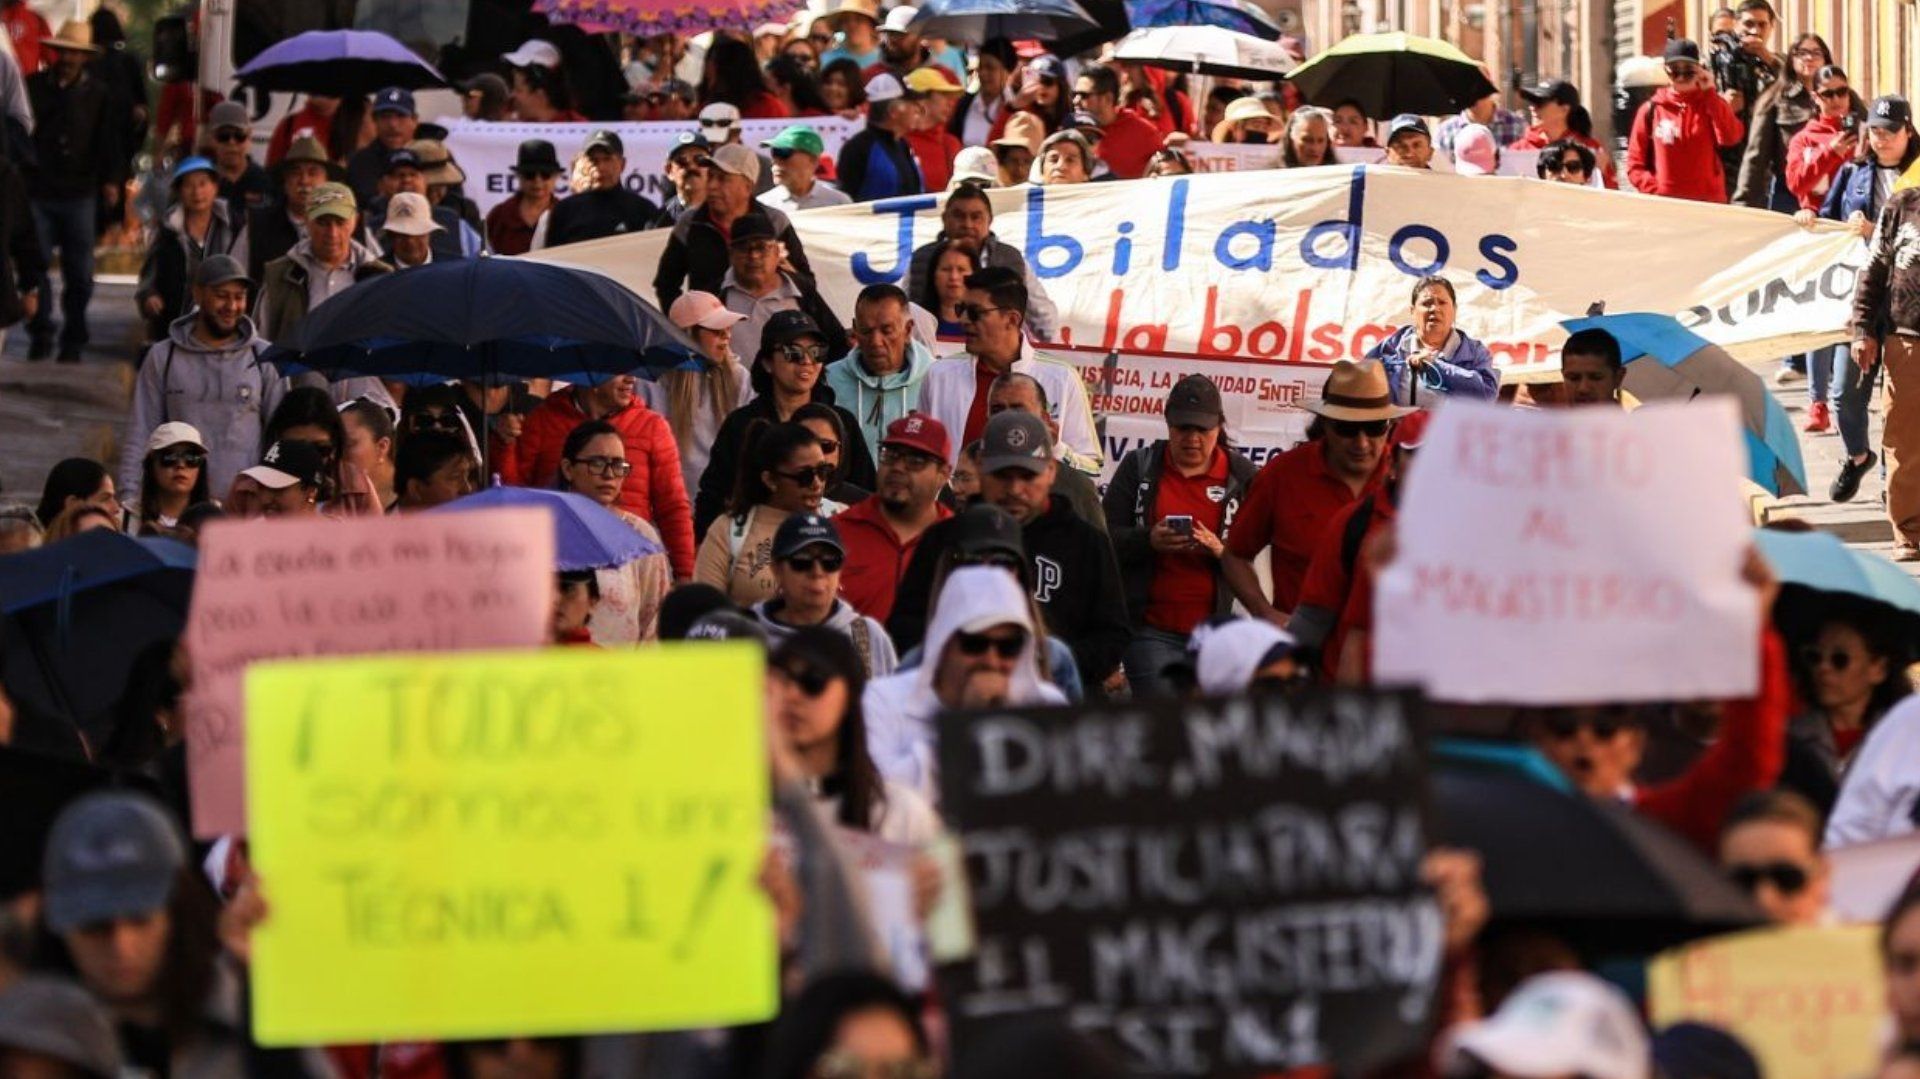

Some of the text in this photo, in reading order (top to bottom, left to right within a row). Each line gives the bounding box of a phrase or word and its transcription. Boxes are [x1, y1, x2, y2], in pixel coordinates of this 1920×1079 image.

[851, 165, 1520, 290] Jbilados
[1102, 288, 1168, 353] la
[1150, 371, 1172, 389] LA
[1258, 378, 1301, 403] SNTE
[1088, 393, 1165, 415] ENSIONA
[1455, 417, 1653, 489] RESPETO
[1517, 504, 1579, 551] AL
[1034, 555, 1062, 602] P
